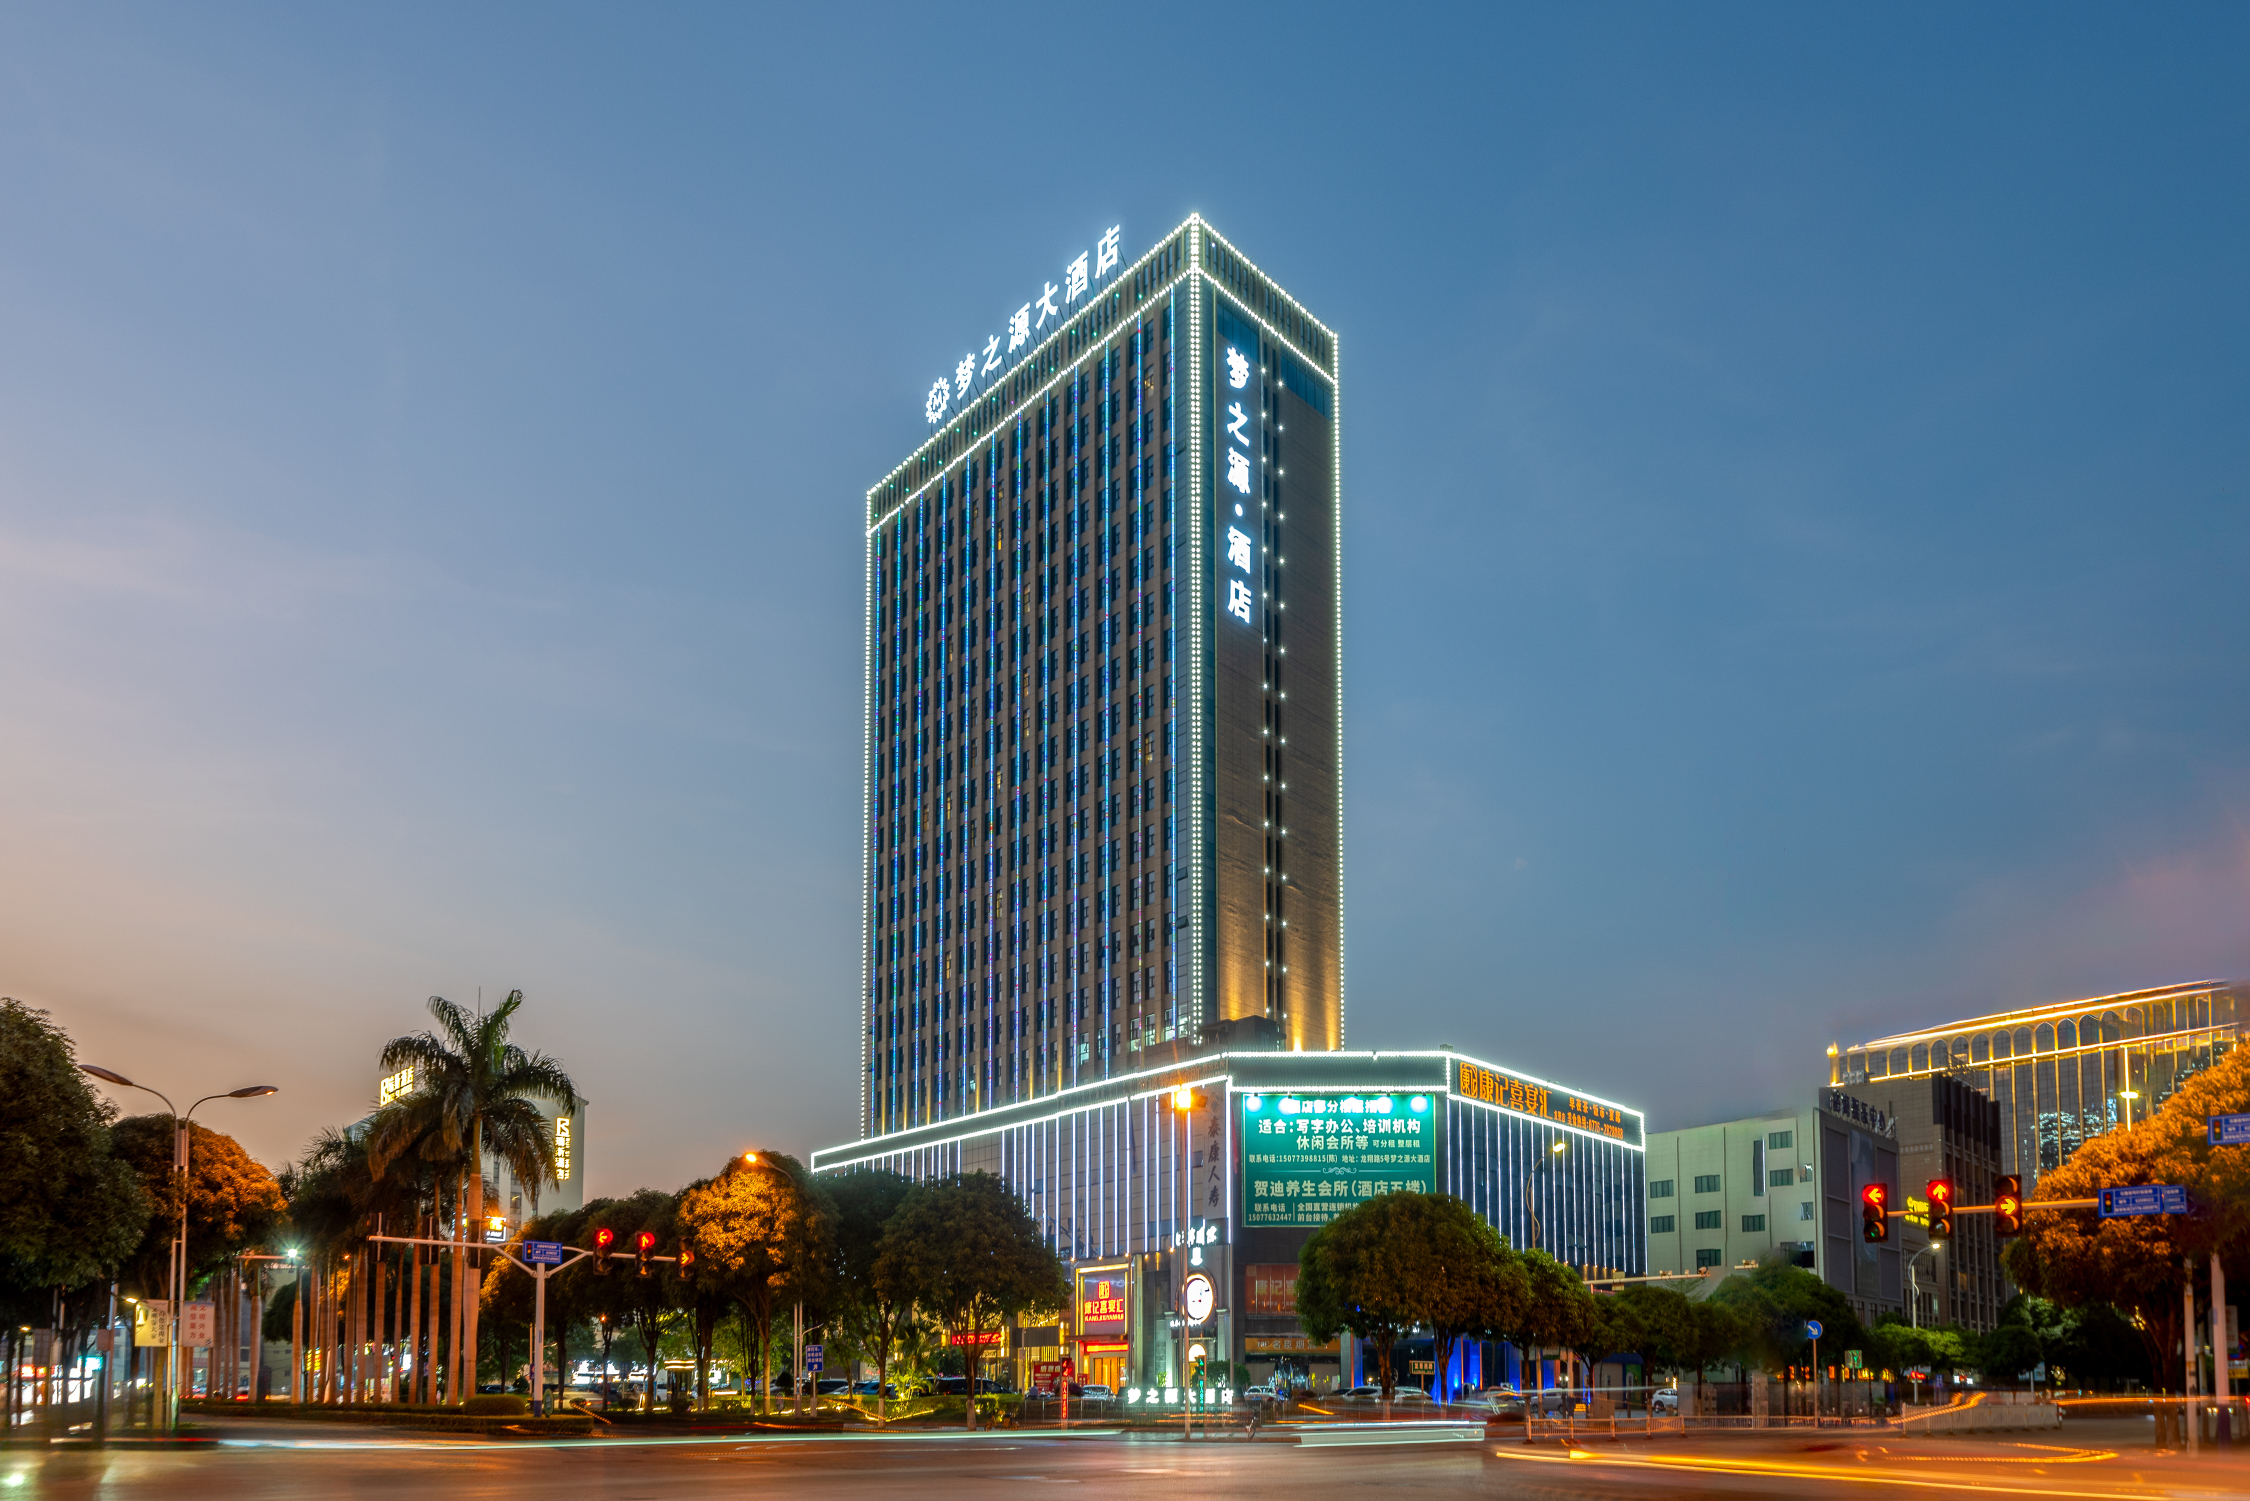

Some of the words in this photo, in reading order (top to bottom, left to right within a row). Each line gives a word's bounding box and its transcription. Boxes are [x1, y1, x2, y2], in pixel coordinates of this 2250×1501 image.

[955, 224, 1120, 400] 梦之源大酒店
[1479, 1069, 1553, 1120] 康记喜宴汇
[1208, 1116, 1221, 1207] 泰康人寿
[1296, 1135, 1369, 1150] 休闲会所等
[1254, 1203, 1286, 1212] 联系电话
